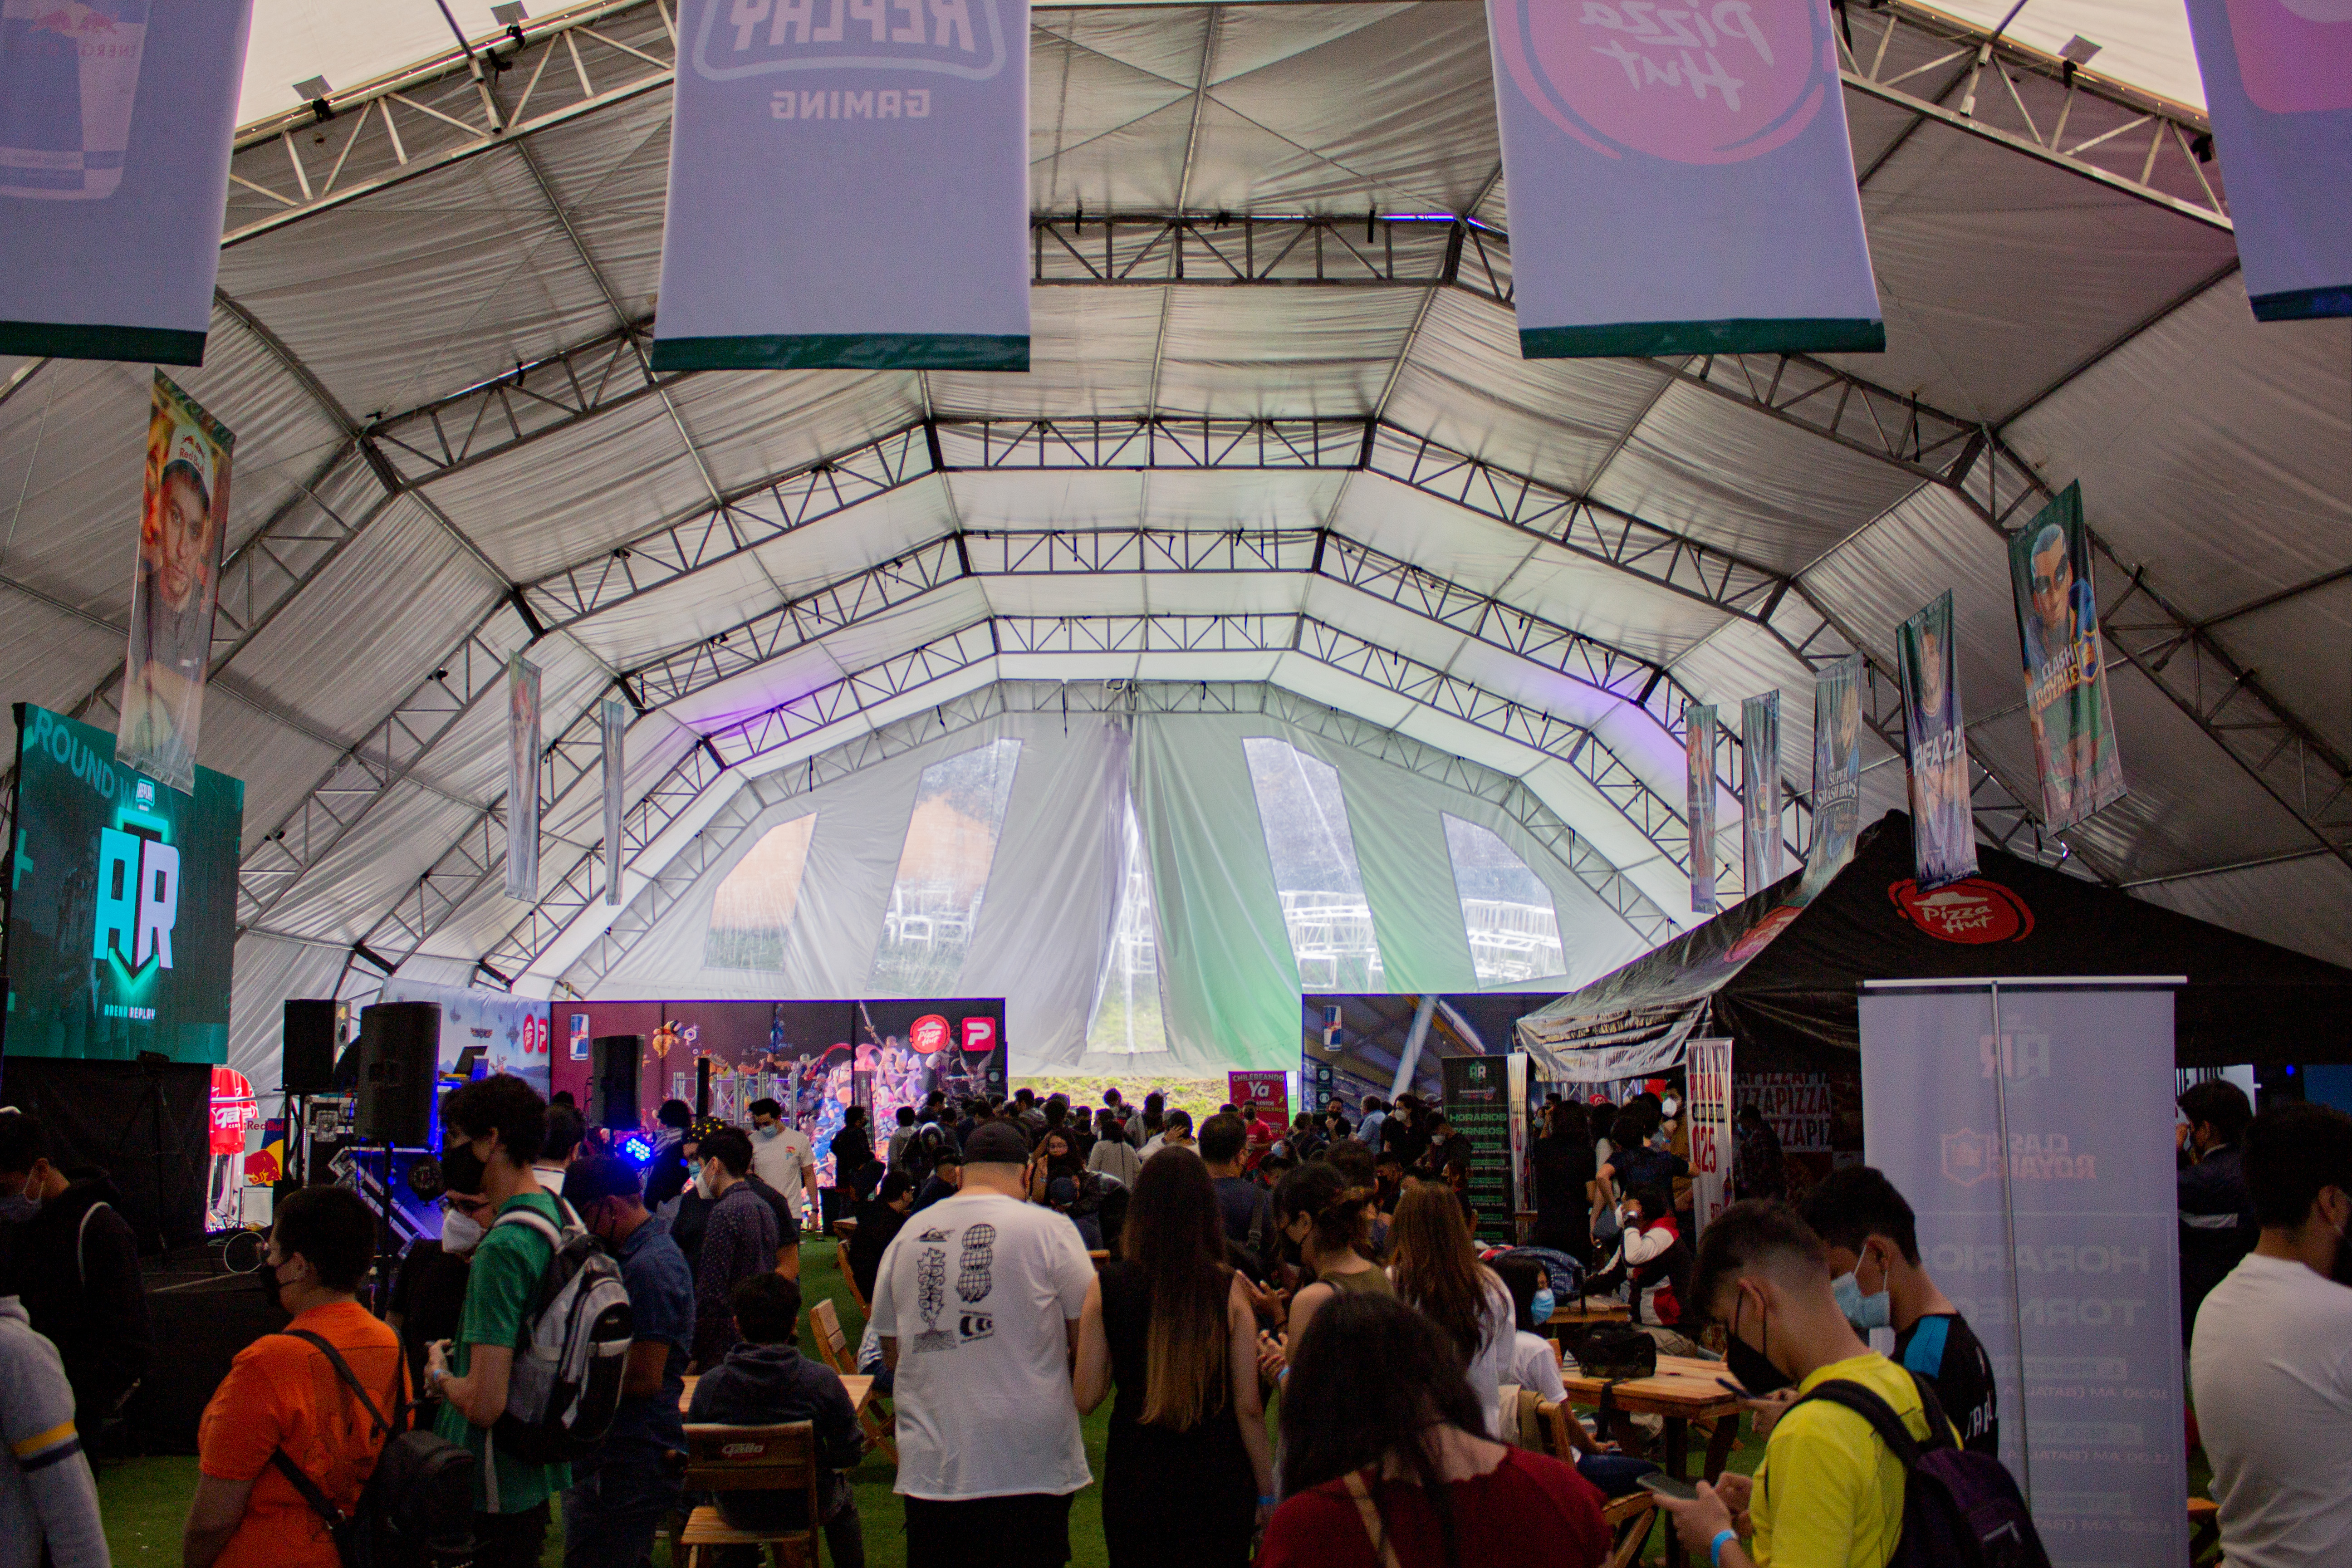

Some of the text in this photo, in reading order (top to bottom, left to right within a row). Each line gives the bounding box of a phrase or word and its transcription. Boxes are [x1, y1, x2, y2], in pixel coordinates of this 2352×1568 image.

[179, 447, 194, 460] Red
[2042, 644, 2076, 682] CLASH
[2035, 664, 2080, 712] ROYALE
[34, 708, 115, 799] ROUND
[1913, 725, 1961, 777] FIFA 22
[1922, 905, 1992, 921] Pizza
[1942, 915, 1995, 934] Hut
[104, 1004, 156, 1020] ARENA REPLAY
[918, 1029, 941, 1041] Pizza
[921, 1037, 939, 1047] Hut
[967, 1023, 991, 1045] P
[1232, 1073, 1284, 1082] CHILEREANDO
[1248, 1081, 1269, 1098] Ya
[247, 1120, 284, 1130] Red Bul
[1450, 1113, 1507, 1122] HORARIOS
